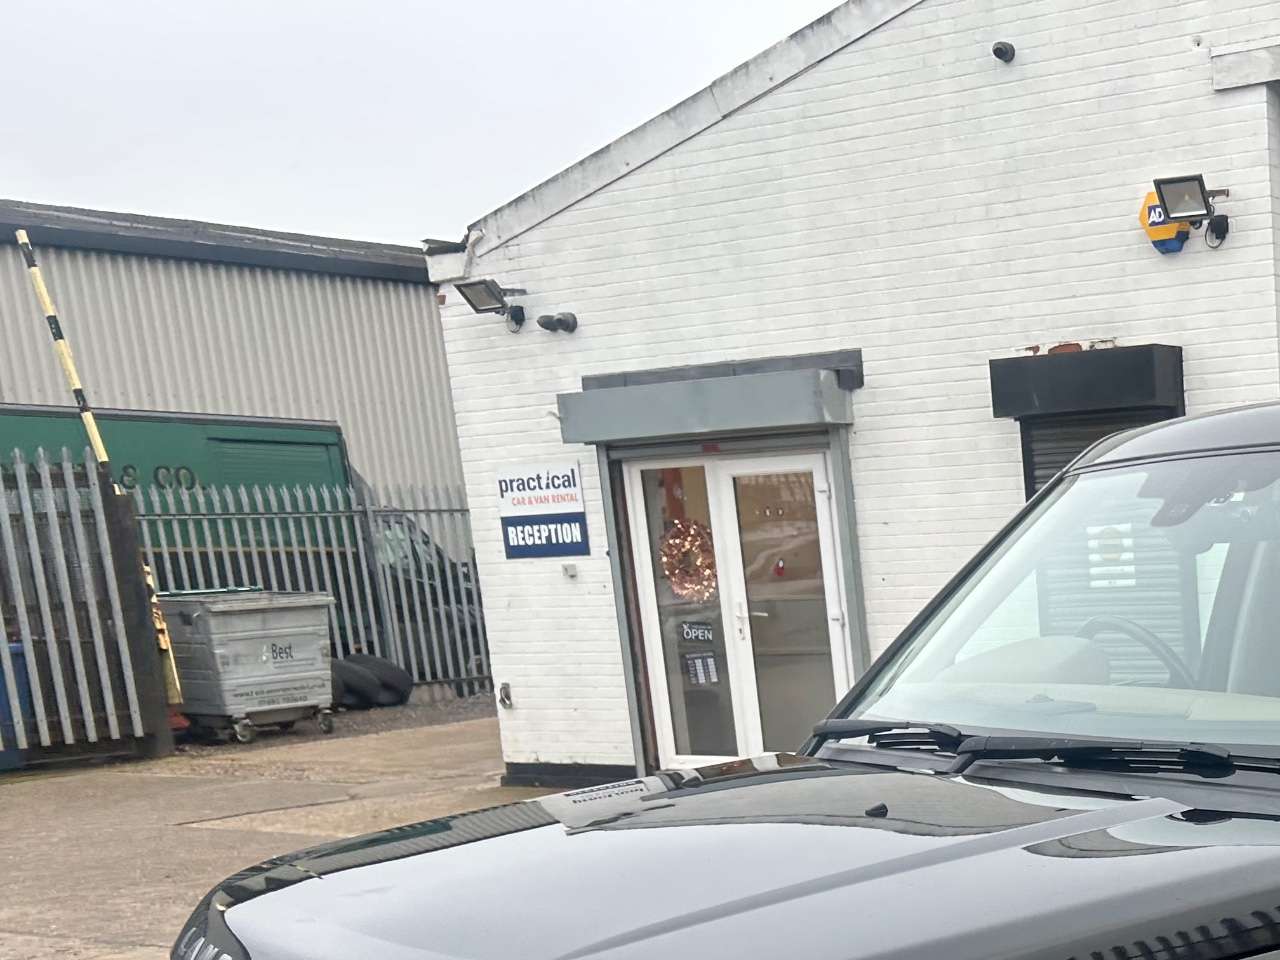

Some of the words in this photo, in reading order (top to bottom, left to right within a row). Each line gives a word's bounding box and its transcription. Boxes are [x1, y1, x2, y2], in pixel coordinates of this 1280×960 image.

[498, 468, 577, 499] practical
[511, 496, 527, 506] CAR
[534, 494, 550, 505] VAN
[551, 492, 578, 504] RENTAL
[507, 522, 582, 546] RECEPTION
[683, 628, 713, 640] OPEN
[271, 642, 294, 660] Best
